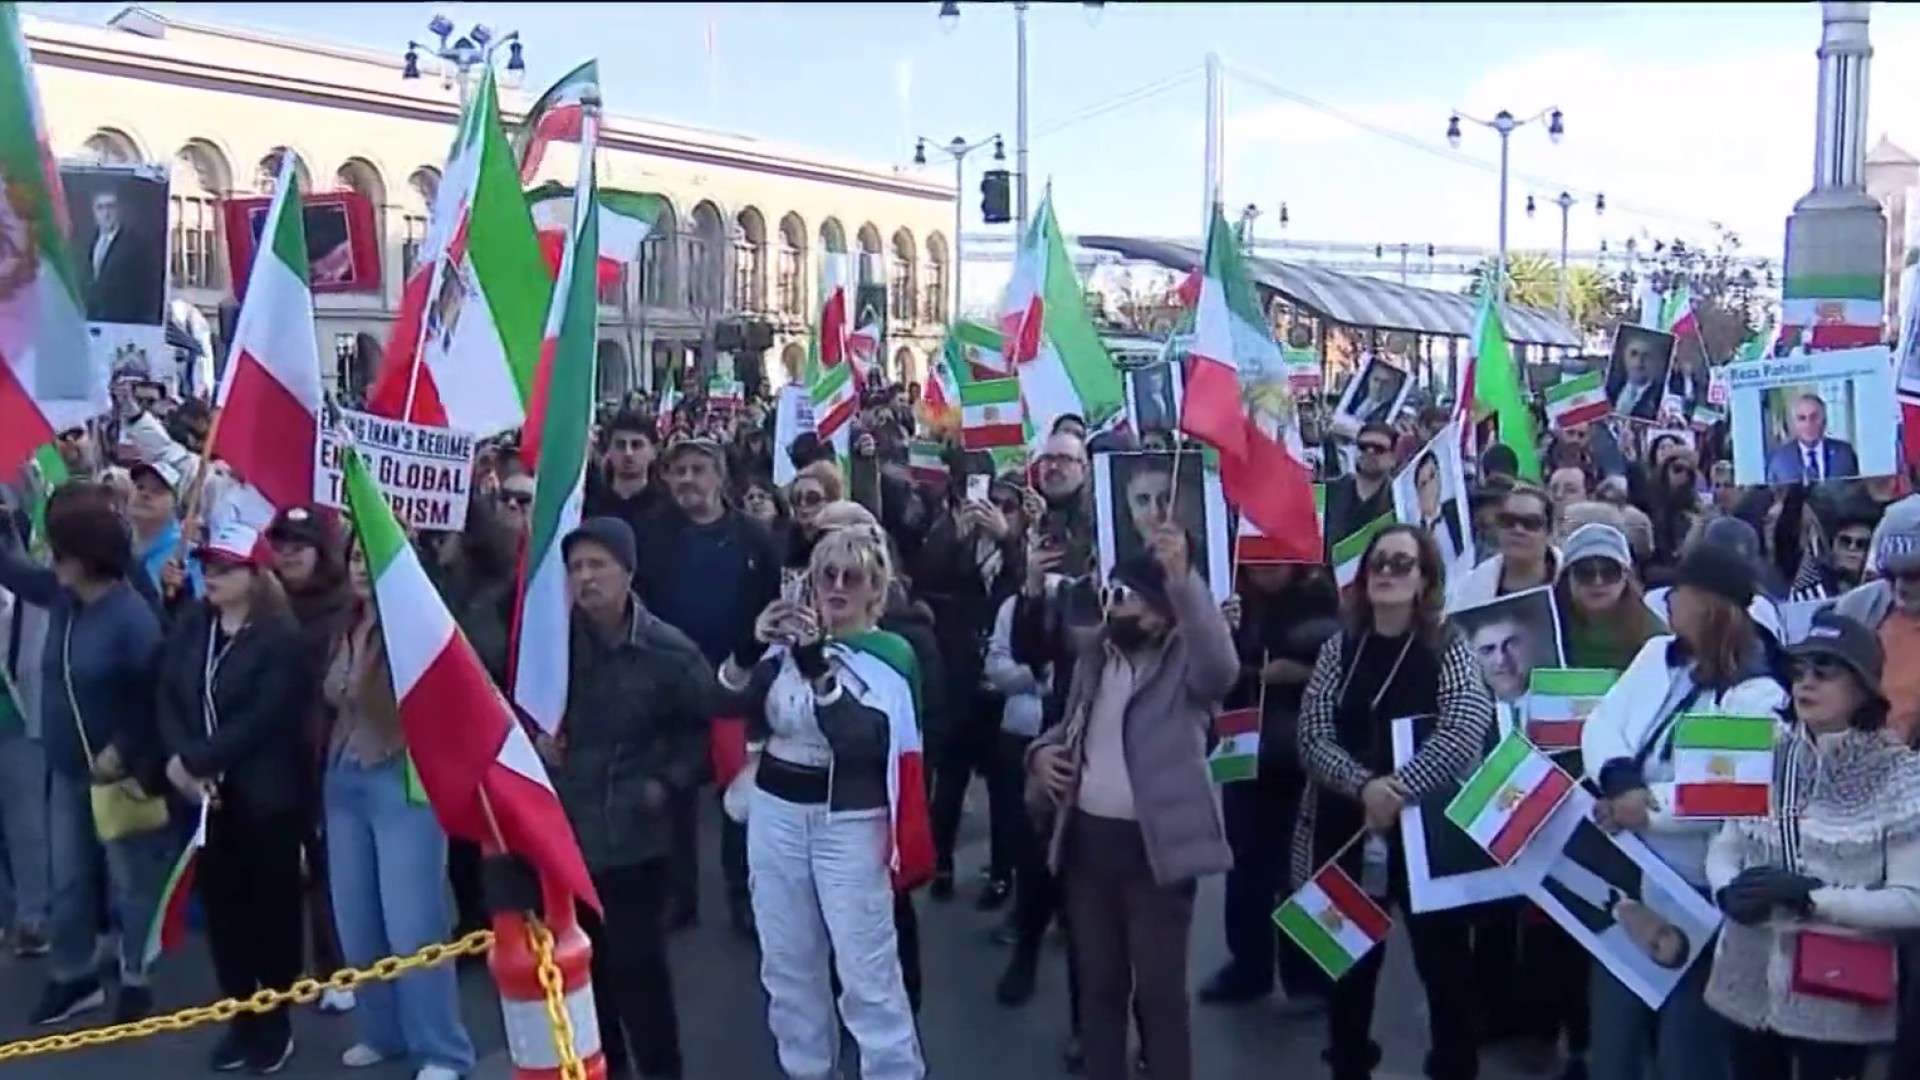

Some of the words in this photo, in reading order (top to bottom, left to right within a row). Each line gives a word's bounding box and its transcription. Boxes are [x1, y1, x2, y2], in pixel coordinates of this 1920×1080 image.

[368, 418, 414, 451] IRAN'S
[417, 429, 471, 458] REGIME
[379, 455, 466, 494] GLOBAL
[329, 473, 451, 524] TERISM
